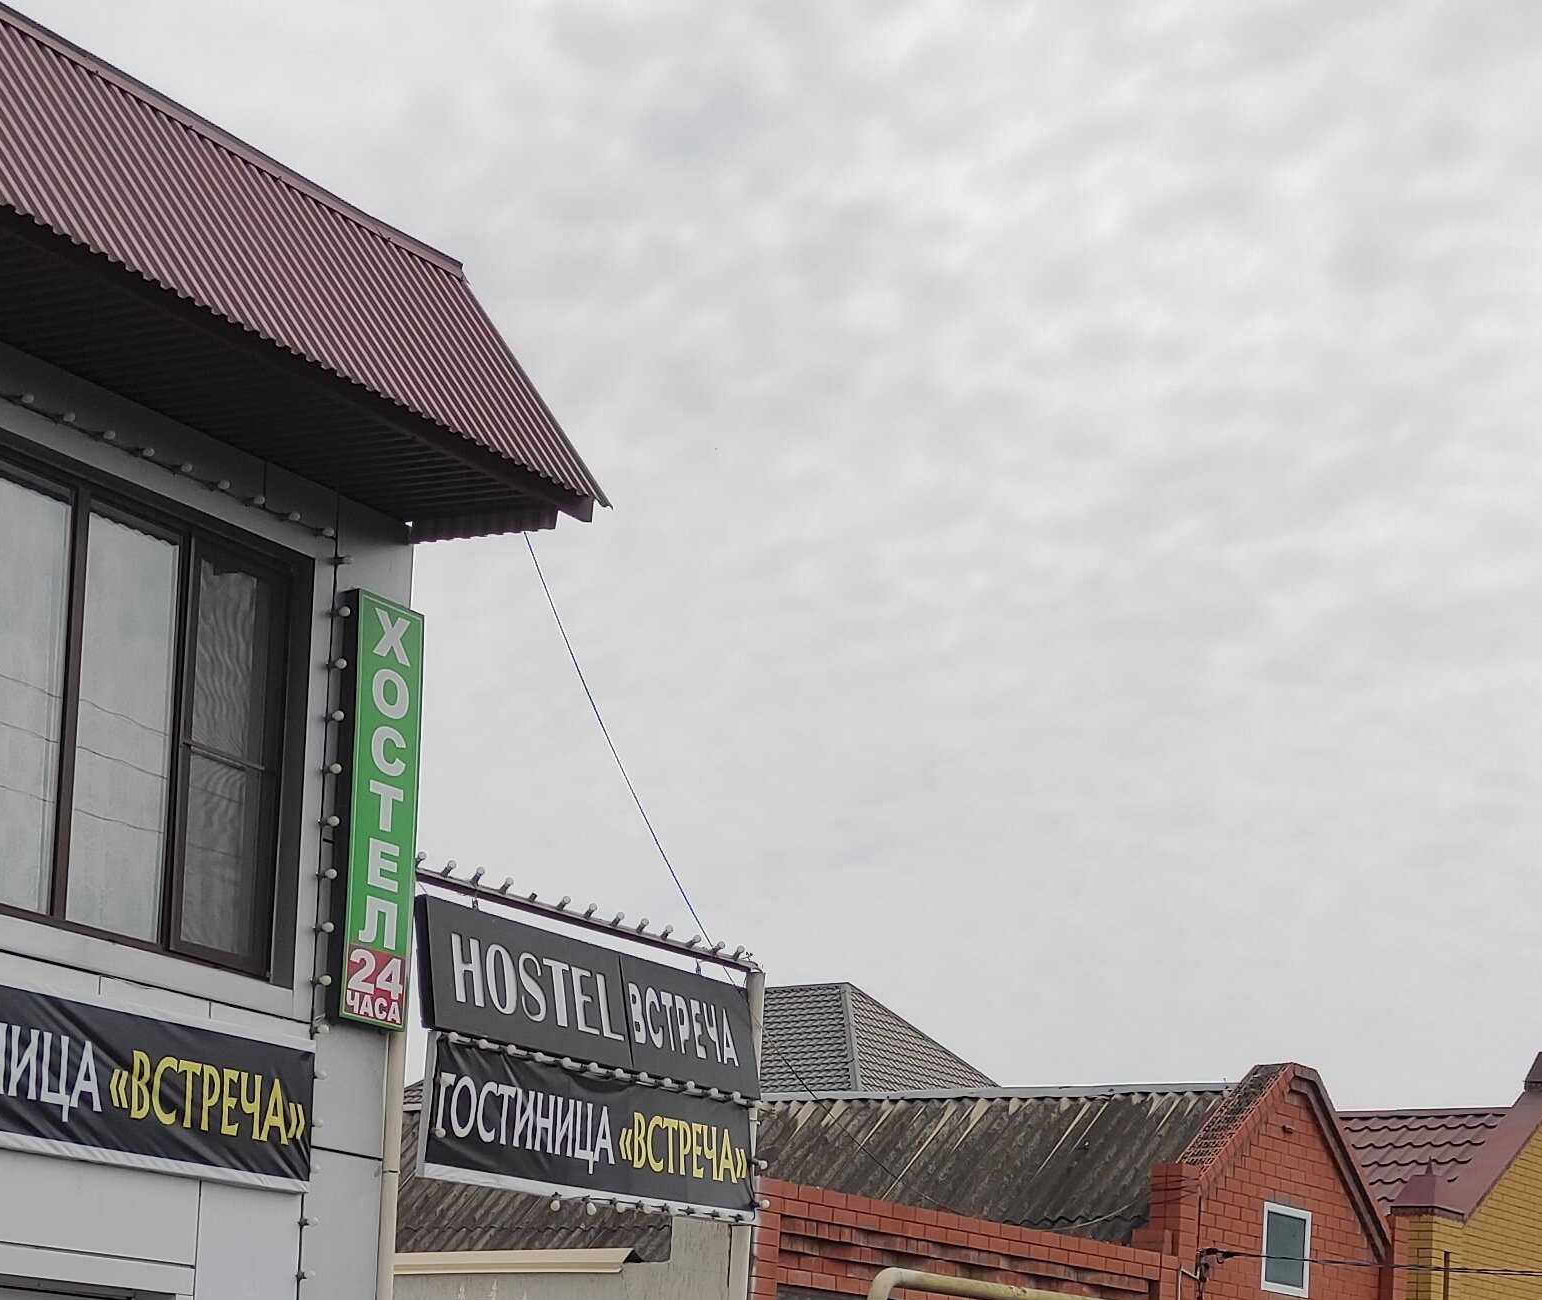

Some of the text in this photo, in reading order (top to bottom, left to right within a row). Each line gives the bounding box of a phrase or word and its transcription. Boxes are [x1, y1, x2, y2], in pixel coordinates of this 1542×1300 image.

[358, 606, 411, 951] ХОСТЕЛ
[345, 989, 402, 1025] ЧАСА
[347, 948, 403, 1000] 24
[451, 932, 625, 1042] HOSTEL
[627, 982, 739, 1068] ВСТРЕЧА
[109, 1050, 307, 1145] «ВСТРЕЧА»
[435, 1072, 748, 1184] ГОСТИНИЦА «ВСТРЕЧА»
